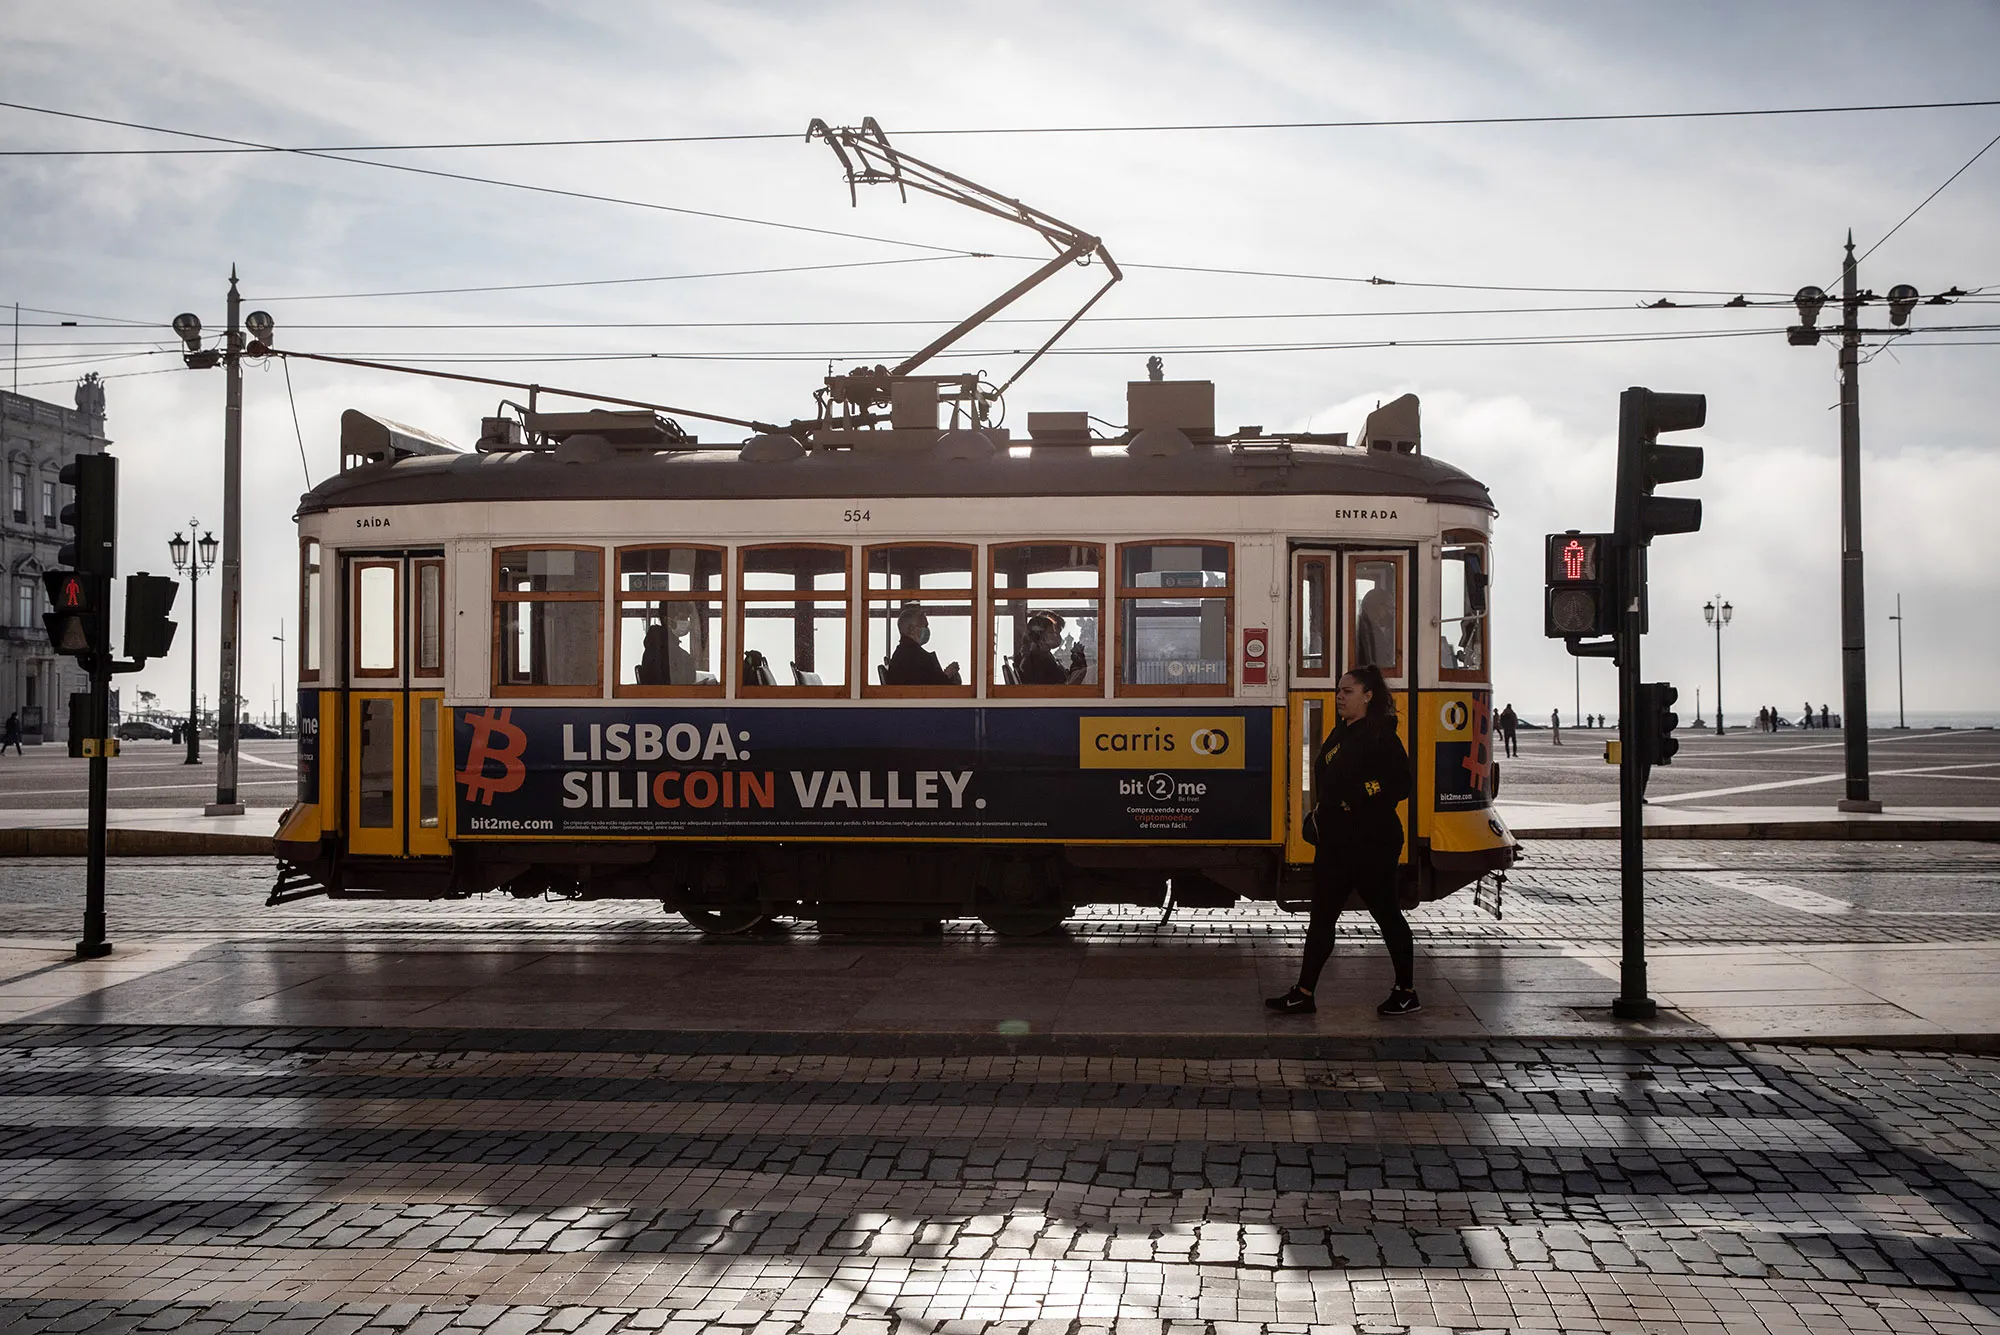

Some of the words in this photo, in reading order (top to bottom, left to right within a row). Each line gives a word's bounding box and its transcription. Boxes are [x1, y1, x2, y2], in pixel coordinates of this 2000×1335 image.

[843, 510, 870, 522] 554
[1335, 510, 1398, 520] ENTRADA
[356, 516, 391, 528] SAÍDA
[1186, 663, 1216, 673] WI-FI
[563, 723, 750, 762] LISBOA:
[1095, 726, 1175, 752] carris
[562, 770, 774, 809] SILICOIN
[790, 771, 986, 809] VALLEY.
[1134, 814, 1192, 822] criptomoedas
[471, 818, 553, 831] bit2me.com
